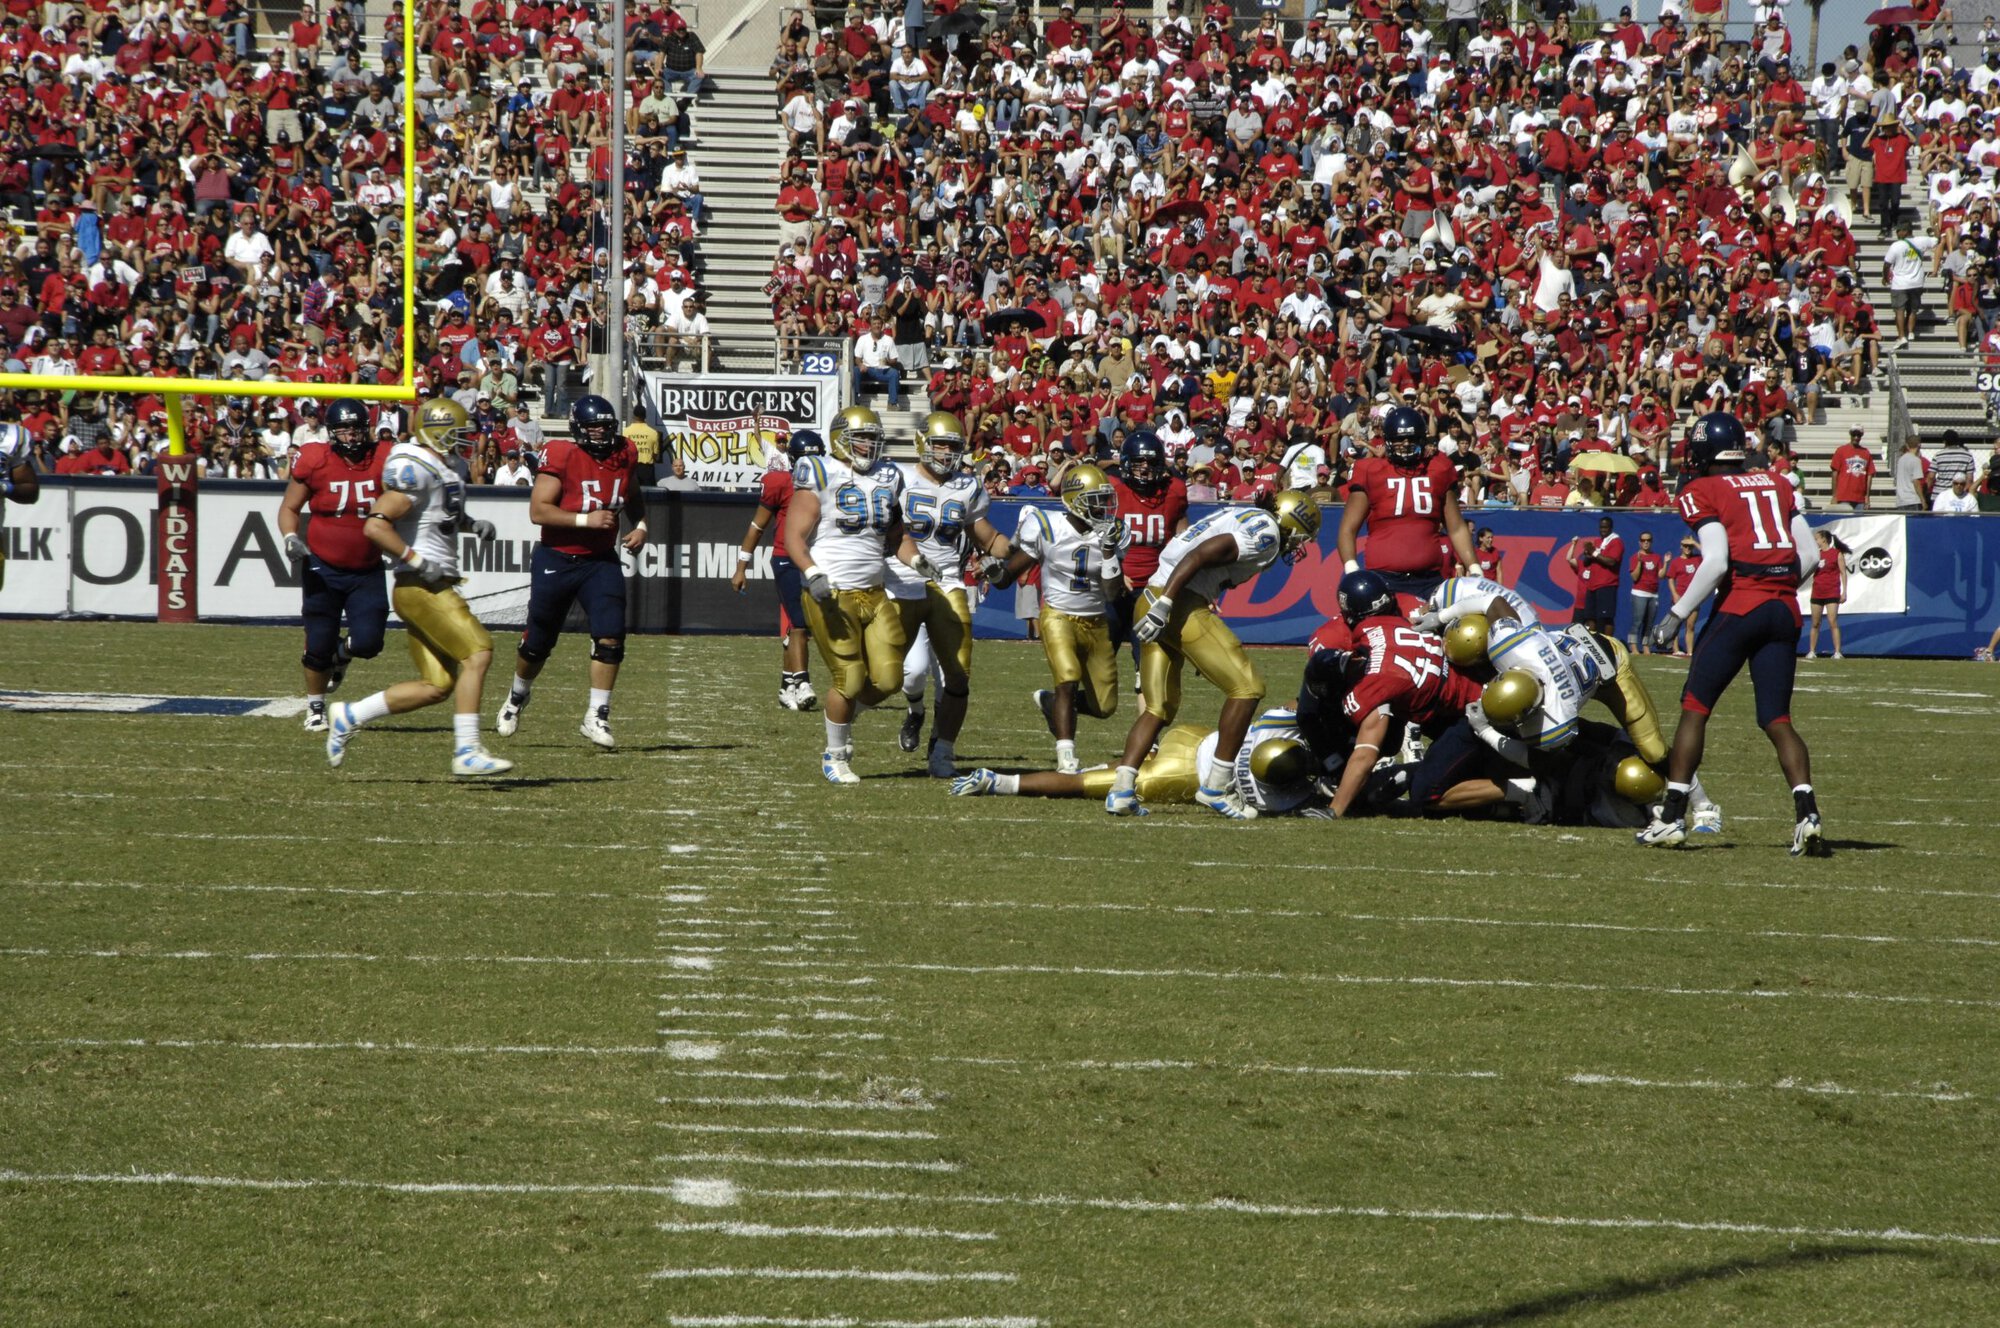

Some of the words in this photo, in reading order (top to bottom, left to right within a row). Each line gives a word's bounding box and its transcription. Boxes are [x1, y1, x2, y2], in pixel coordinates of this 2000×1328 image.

[806, 355, 834, 373] 29
[1800, 357, 1808, 370] 5
[663, 388, 814, 418] BRUEGGER'S
[696, 418, 737, 431] BAKED
[329, 480, 377, 519] 75
[836, 483, 893, 535] 90
[1387, 476, 1433, 516] 76
[1680, 493, 1700, 518] 11
[161, 463, 191, 610] WILDCATS
[1246, 519, 1278, 552] 14
[1740, 489, 1793, 549] 11
[1069, 544, 1091, 592] 1
[1859, 552, 1892, 569] abc
[1538, 645, 1575, 701] CARTER
[1237, 740, 1258, 803] LOMBARD
